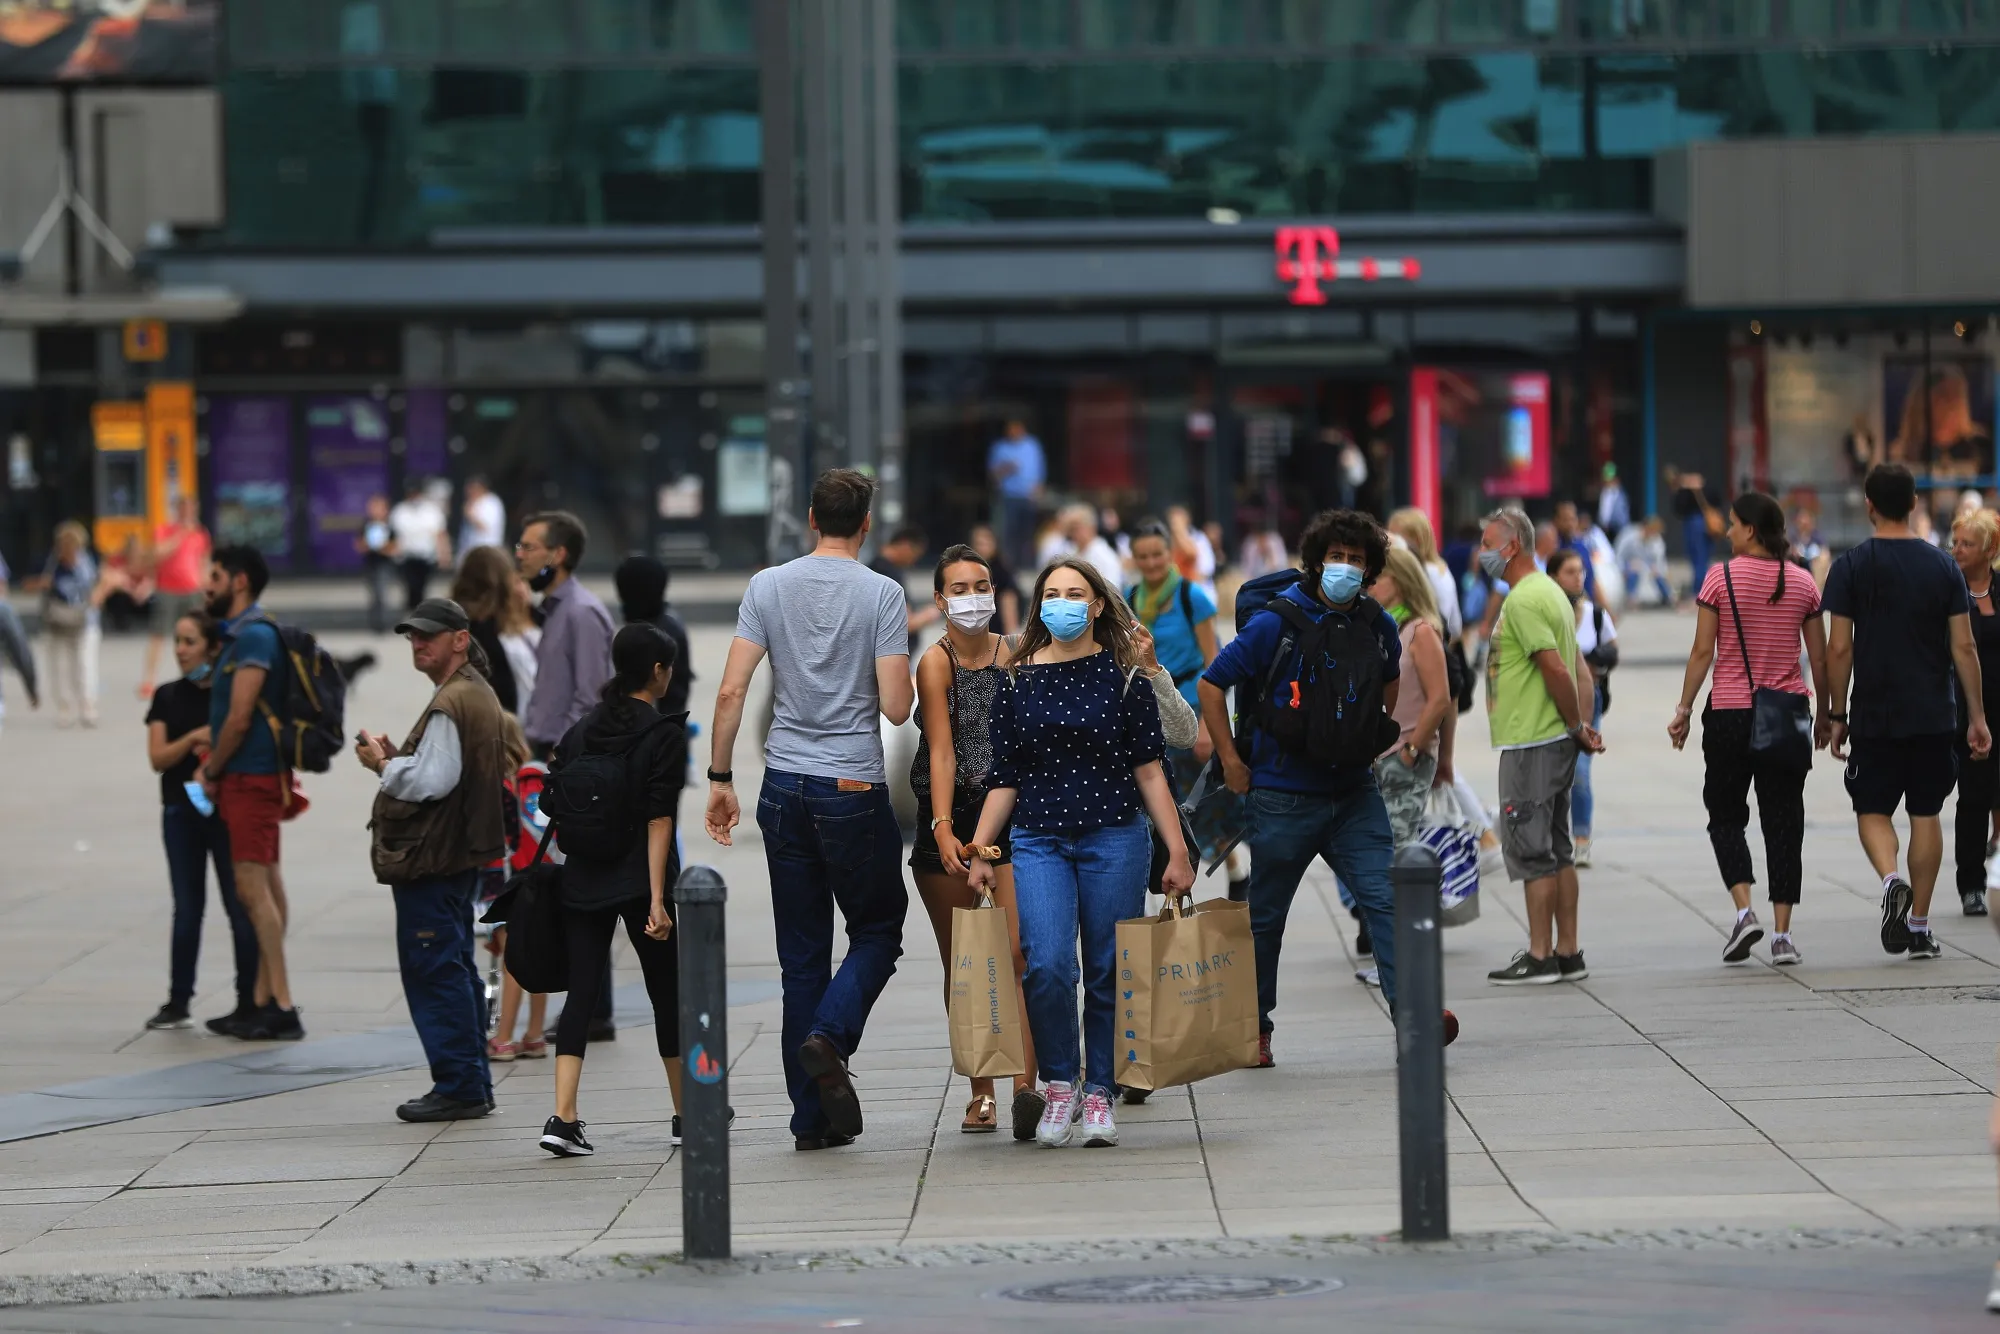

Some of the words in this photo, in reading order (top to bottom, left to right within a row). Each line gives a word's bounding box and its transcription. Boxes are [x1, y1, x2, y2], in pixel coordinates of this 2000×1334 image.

[1275, 225, 1340, 305] T
[987, 955, 1002, 1034] primark.com
[1158, 952, 1232, 982] PRIMARK
